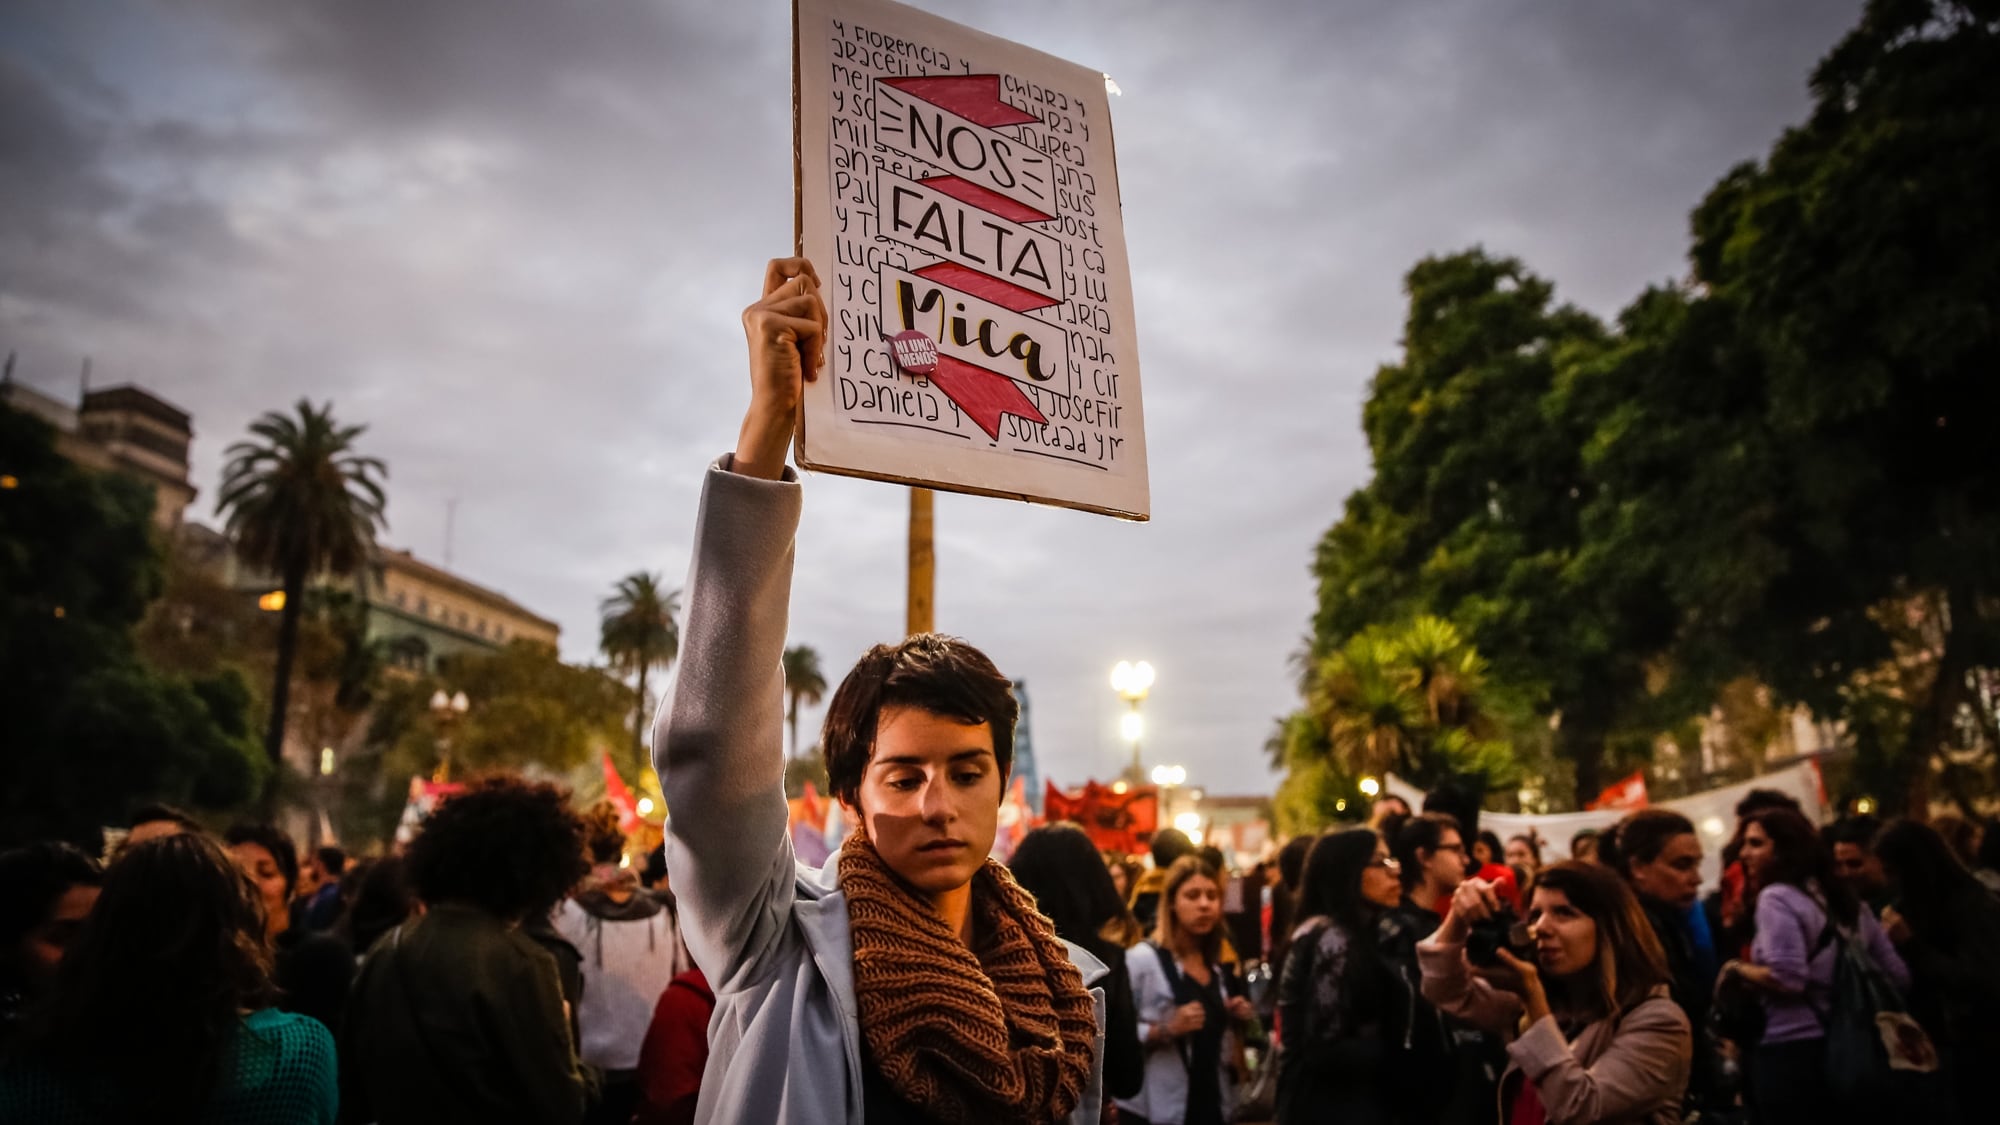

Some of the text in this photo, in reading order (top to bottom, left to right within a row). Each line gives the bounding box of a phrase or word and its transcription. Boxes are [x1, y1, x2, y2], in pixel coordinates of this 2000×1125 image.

[832, 19, 844, 38] y
[832, 91, 844, 112] y
[1074, 98, 1085, 118] y
[909, 103, 1016, 188] NOS
[1079, 122, 1089, 142] y
[836, 205, 848, 233] y
[892, 185, 1052, 290] FALTA
[1064, 243, 1074, 267] y
[838, 273, 852, 301] y
[1064, 271, 1077, 296] y
[896, 278, 1056, 382] Mica
[838, 344, 852, 373] y
[894, 340, 909, 354] NI
[899, 350, 938, 367] MENOS
[1070, 359, 1082, 390] y
[839, 376, 961, 428] Daniela y
[1093, 432, 1104, 461] y
